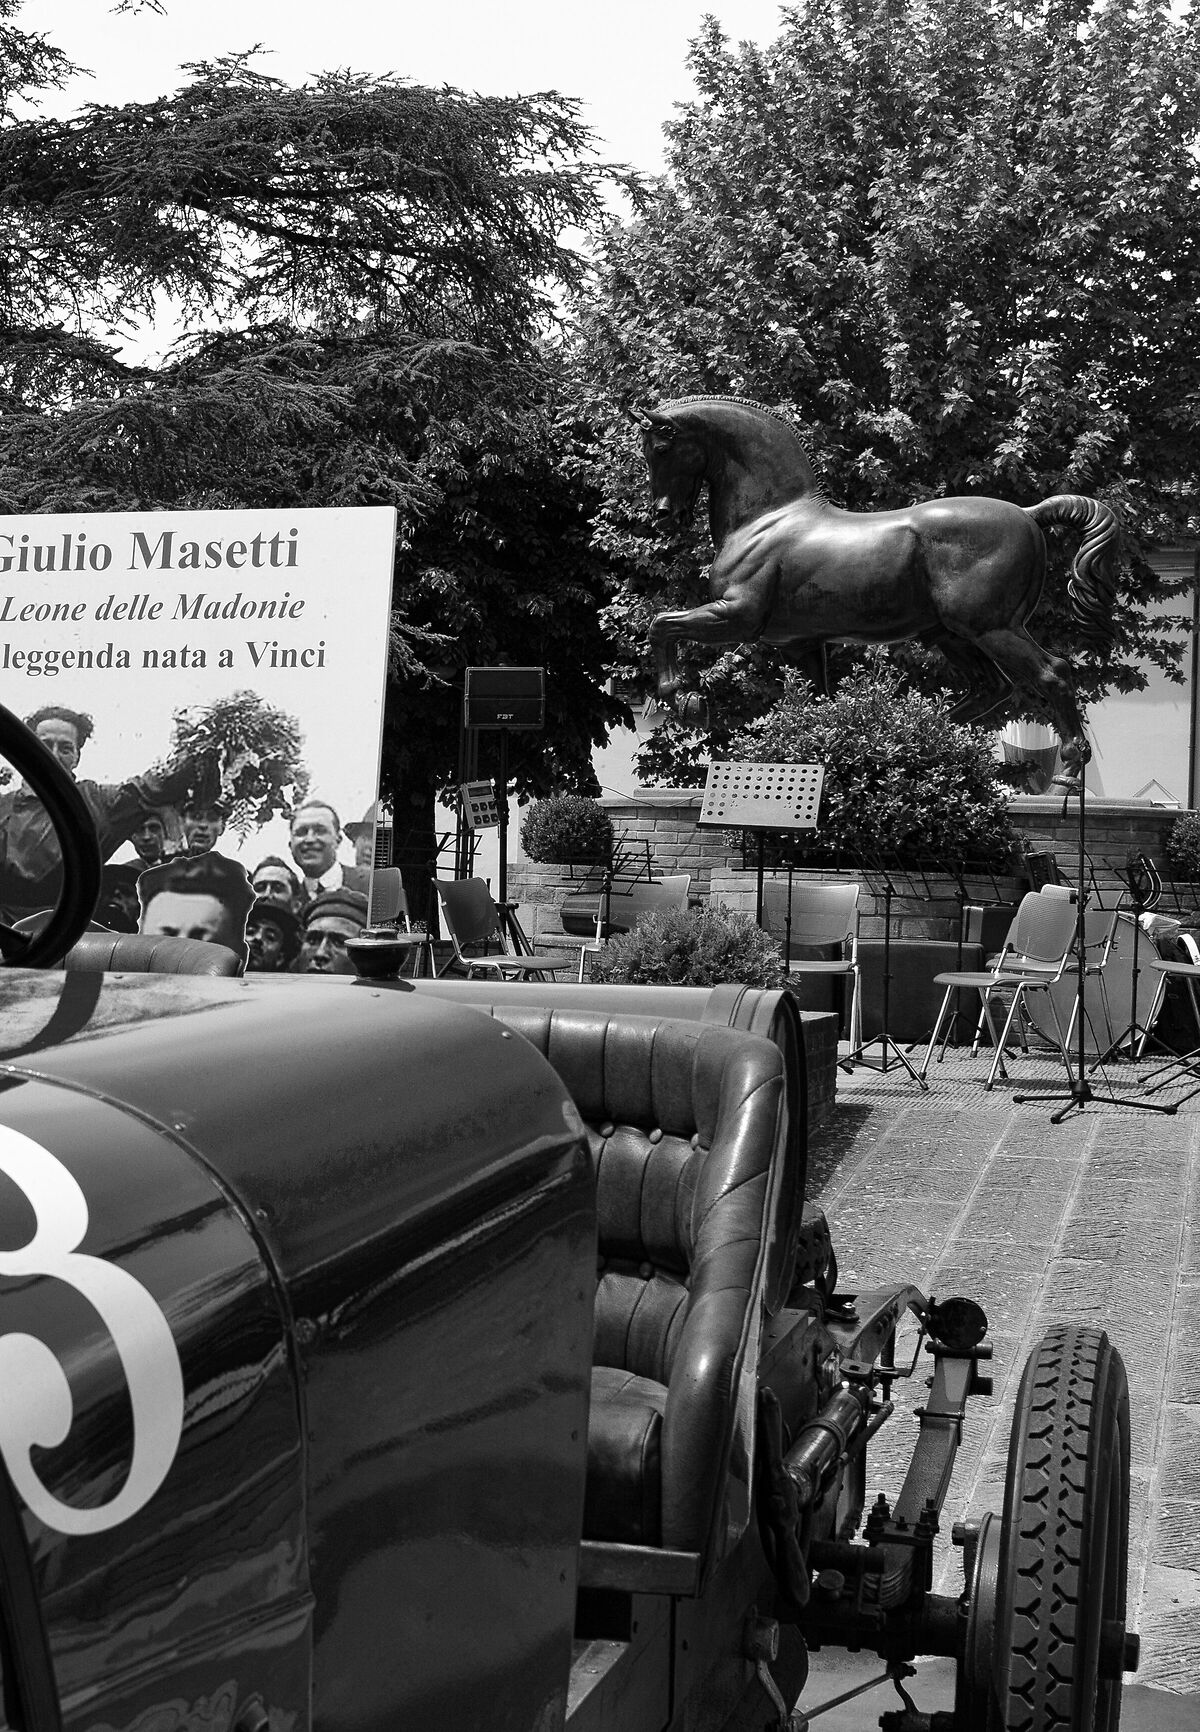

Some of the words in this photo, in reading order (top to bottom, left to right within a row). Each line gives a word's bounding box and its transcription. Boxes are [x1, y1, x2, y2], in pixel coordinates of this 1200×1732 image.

[127, 527, 300, 570] Masetti
[94, 593, 164, 622] delle
[171, 591, 306, 620] Madonie
[2, 643, 131, 677] leggenda
[142, 644, 207, 669] nata
[218, 649, 235, 669] a
[245, 640, 327, 669] Vinci
